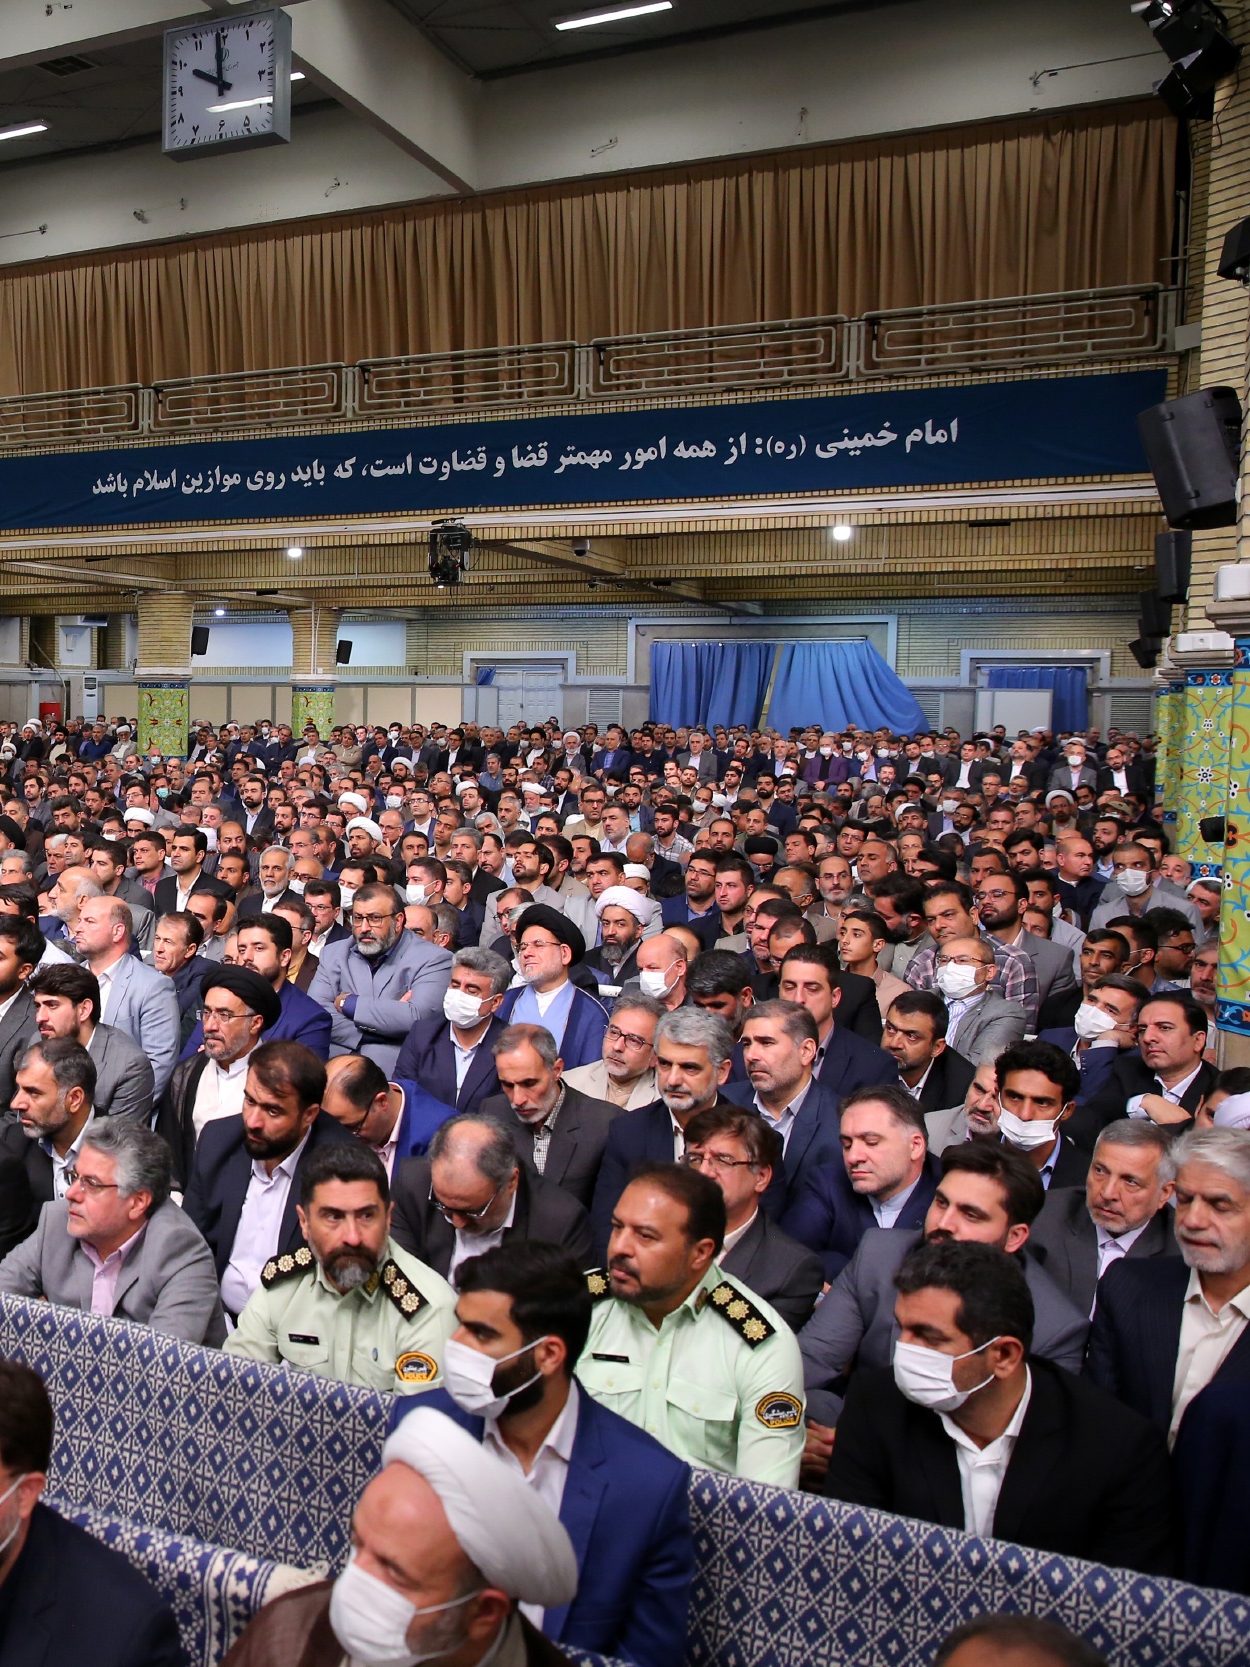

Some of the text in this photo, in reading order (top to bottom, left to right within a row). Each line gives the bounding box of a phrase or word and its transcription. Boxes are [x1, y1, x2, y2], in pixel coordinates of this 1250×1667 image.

[195, 40, 203, 52] ۱۱
[259, 41, 266, 54] ۲
[258, 69, 266, 82] ۳
[177, 113, 185, 124] ۸
[192, 125, 200, 136] ۷
[673, 439, 717, 459] همه
[723, 433, 747, 465] از
[815, 422, 898, 459] خمینی
[905, 418, 958, 454] امام
[361, 452, 413, 478] است،
[418, 446, 487, 481] قضاوت
[511, 441, 549, 469] قضا
[553, 445, 613, 474] مهمتر
[618, 435, 667, 470] امور
[181, 465, 241, 495] موازین
[290, 458, 326, 488] باید
[333, 456, 357, 479] که
[492, 456, 506, 478] و
[92, 472, 128, 498] باشد
[132, 468, 177, 498] اسلام
[246, 470, 286, 491] روی
